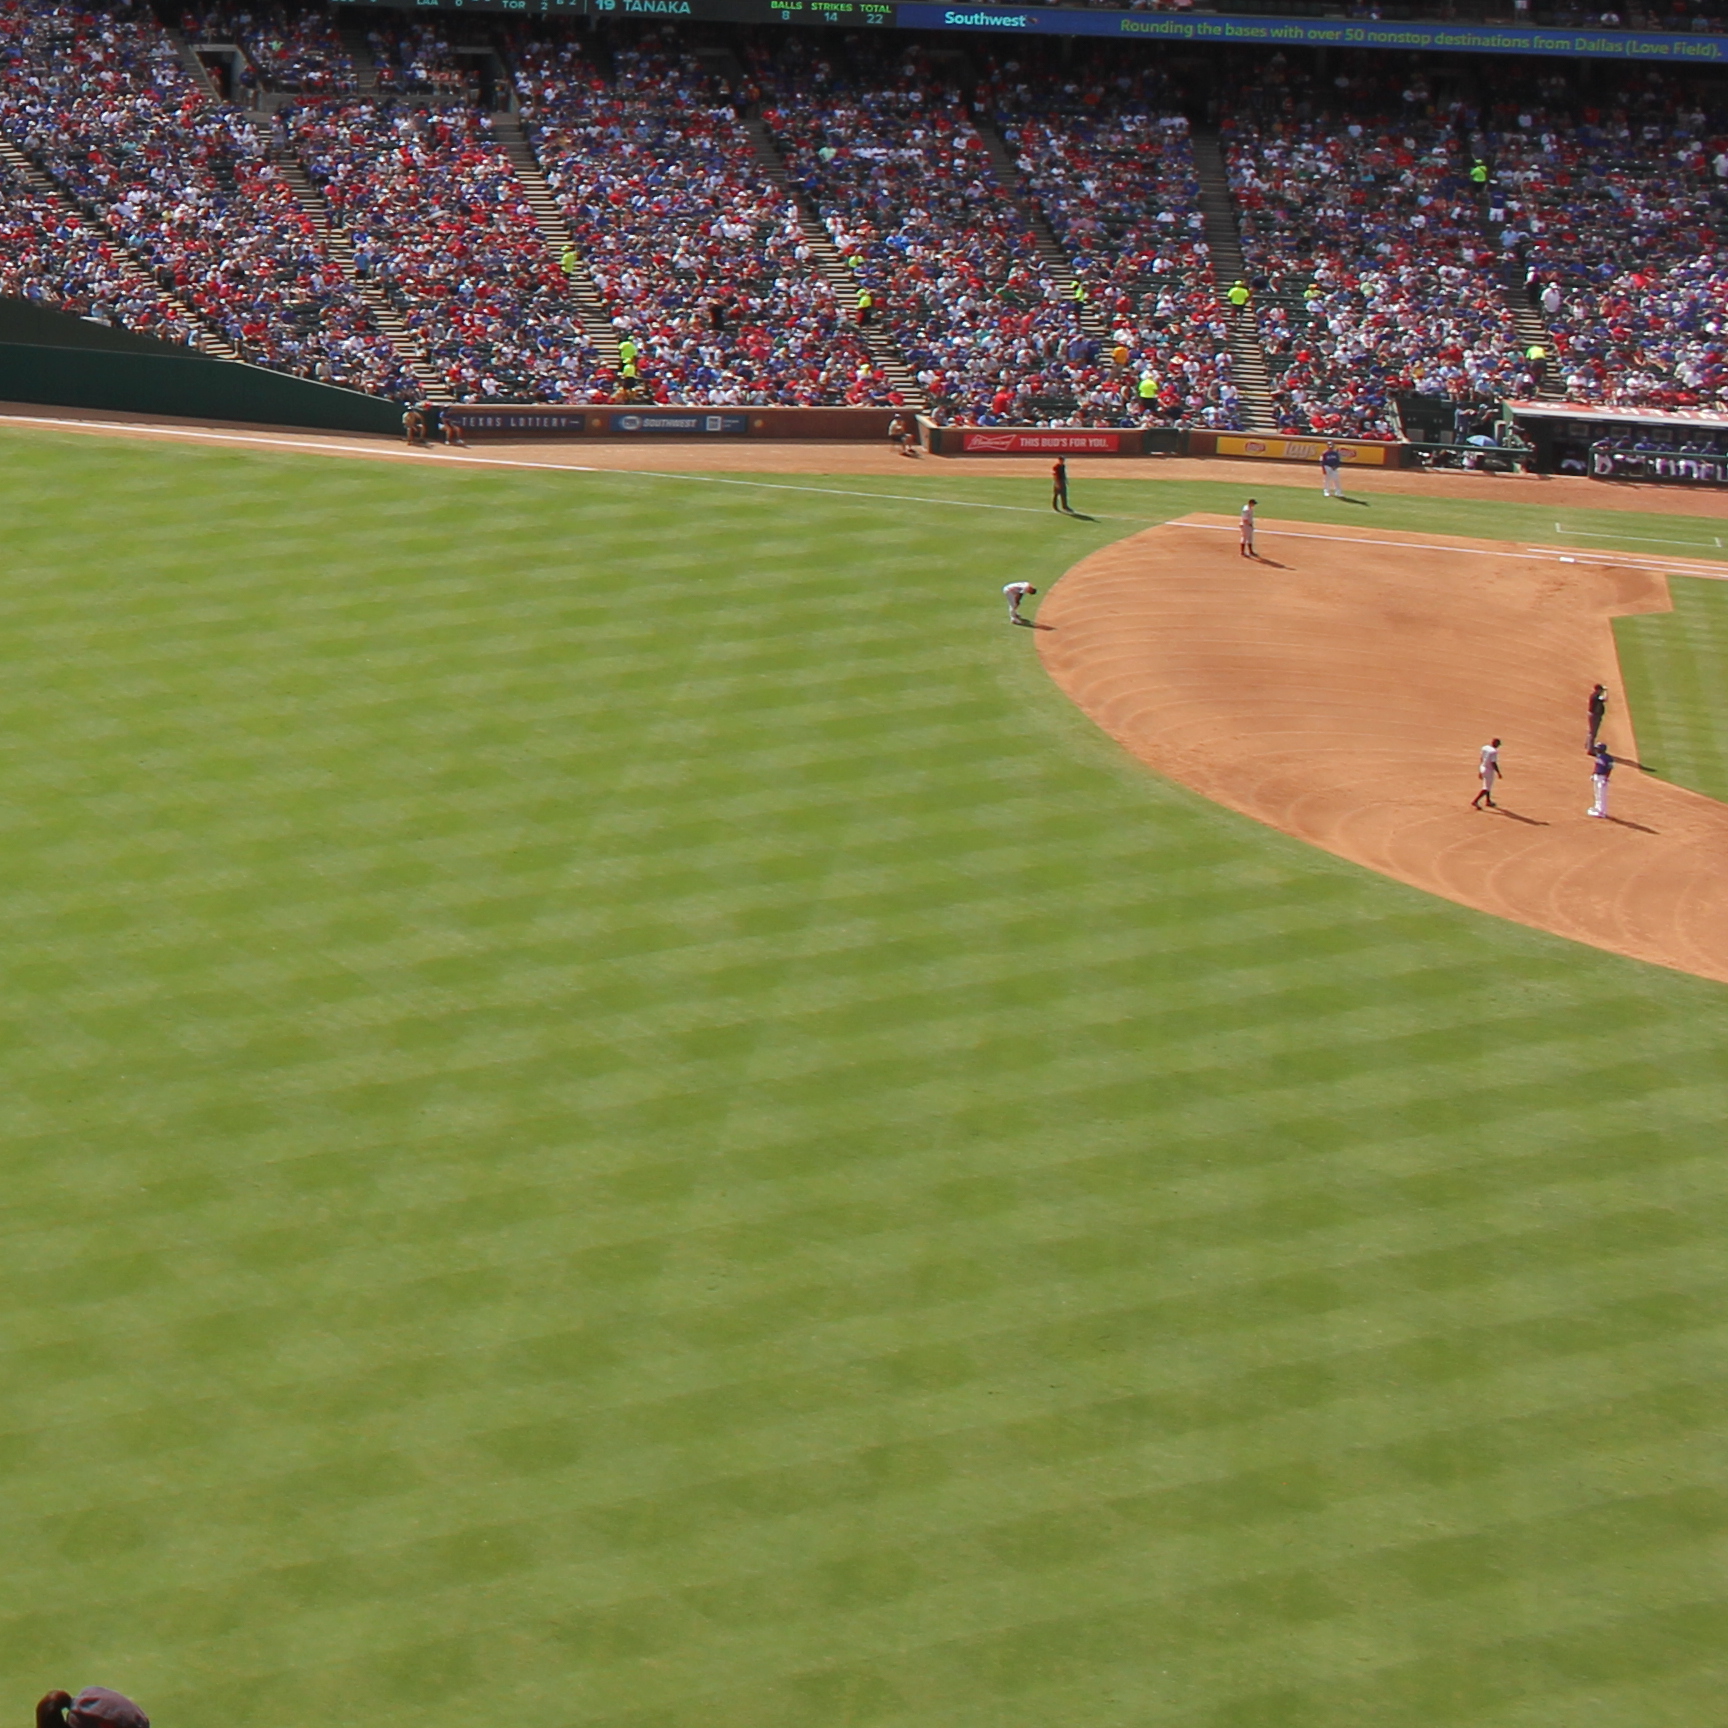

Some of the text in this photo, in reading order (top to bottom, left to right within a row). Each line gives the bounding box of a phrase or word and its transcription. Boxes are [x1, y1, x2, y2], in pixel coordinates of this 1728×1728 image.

[623, 0, 690, 14] TANAKA
[770, 0, 890, 13] BALLS STRIKES TOTAL
[944, 11, 1025, 27] Southwest
[1121, 19, 1721, 59] Rounding the bases with over 50 nonstop destinations from Dallas (Love Field).
[1020, 438, 1039, 446] THIS
[1069, 438, 1086, 447] FOR
[1089, 438, 1108, 447] YOU.
